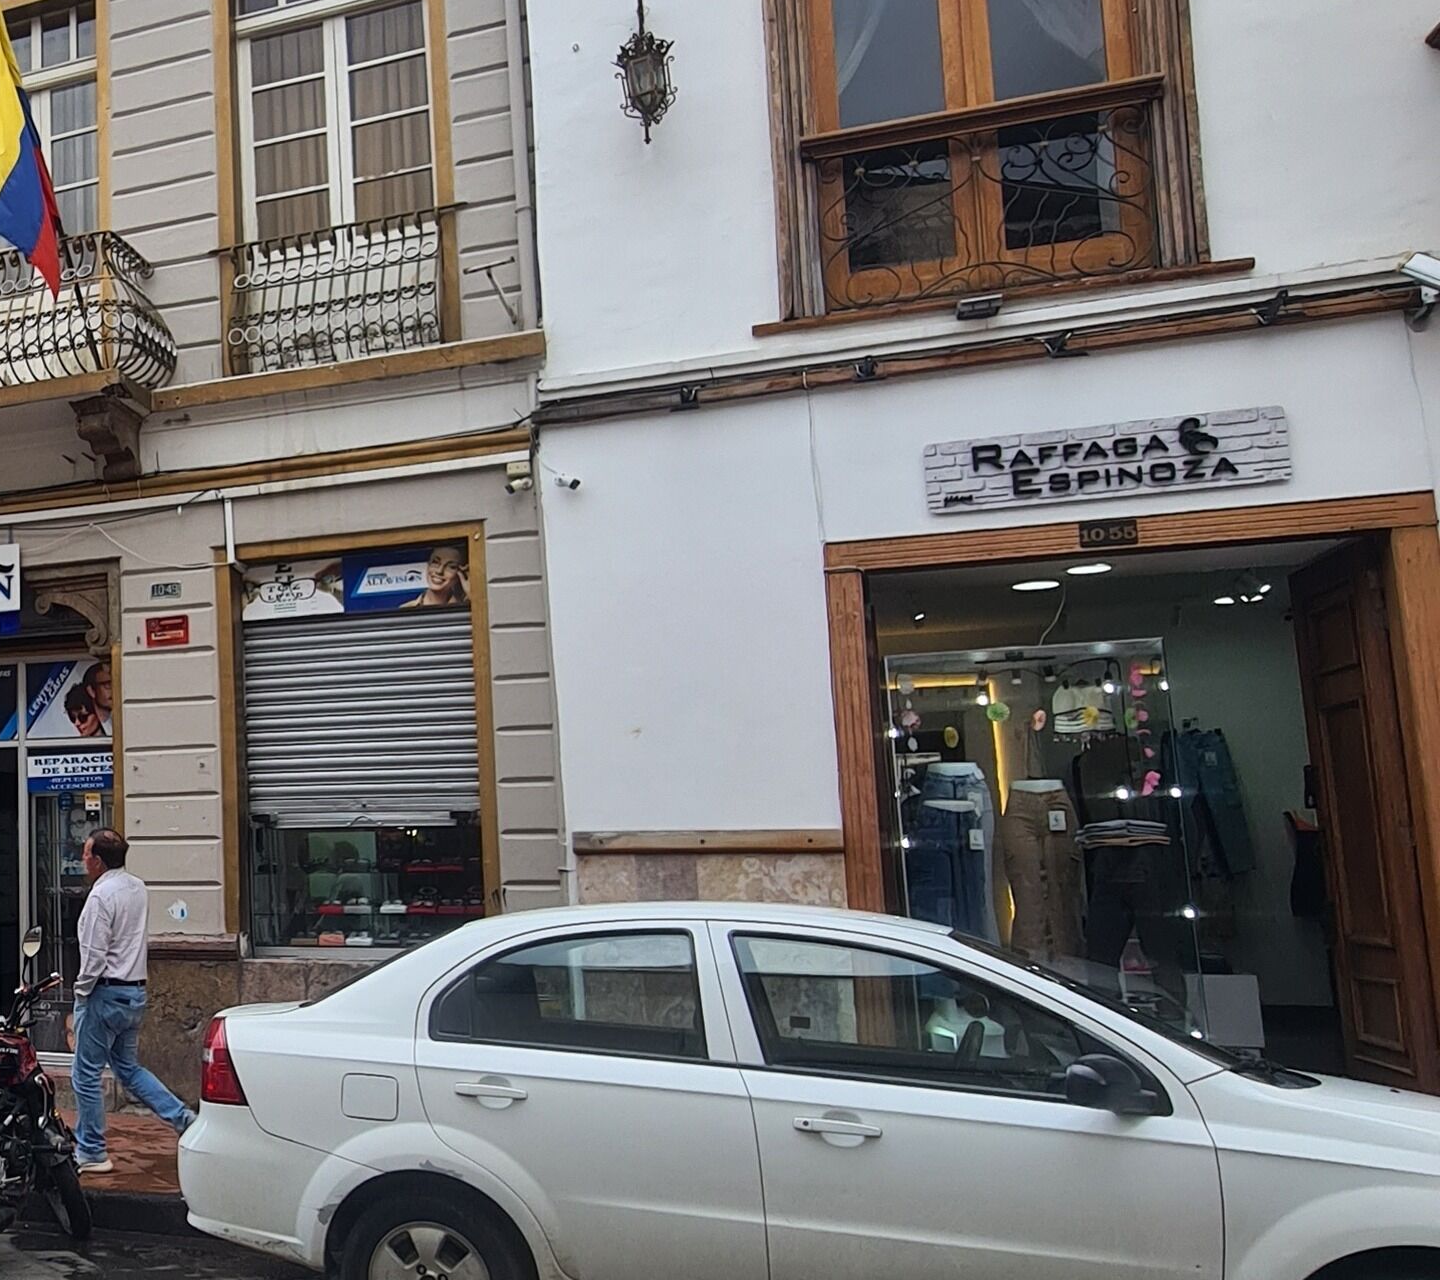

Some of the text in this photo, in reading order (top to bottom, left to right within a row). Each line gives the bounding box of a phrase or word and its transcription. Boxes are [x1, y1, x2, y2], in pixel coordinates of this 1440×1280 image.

[971, 434, 1169, 472] RAFFAGA
[1011, 457, 1239, 496] ESPINOZA
[41, 767, 60, 775] DE
